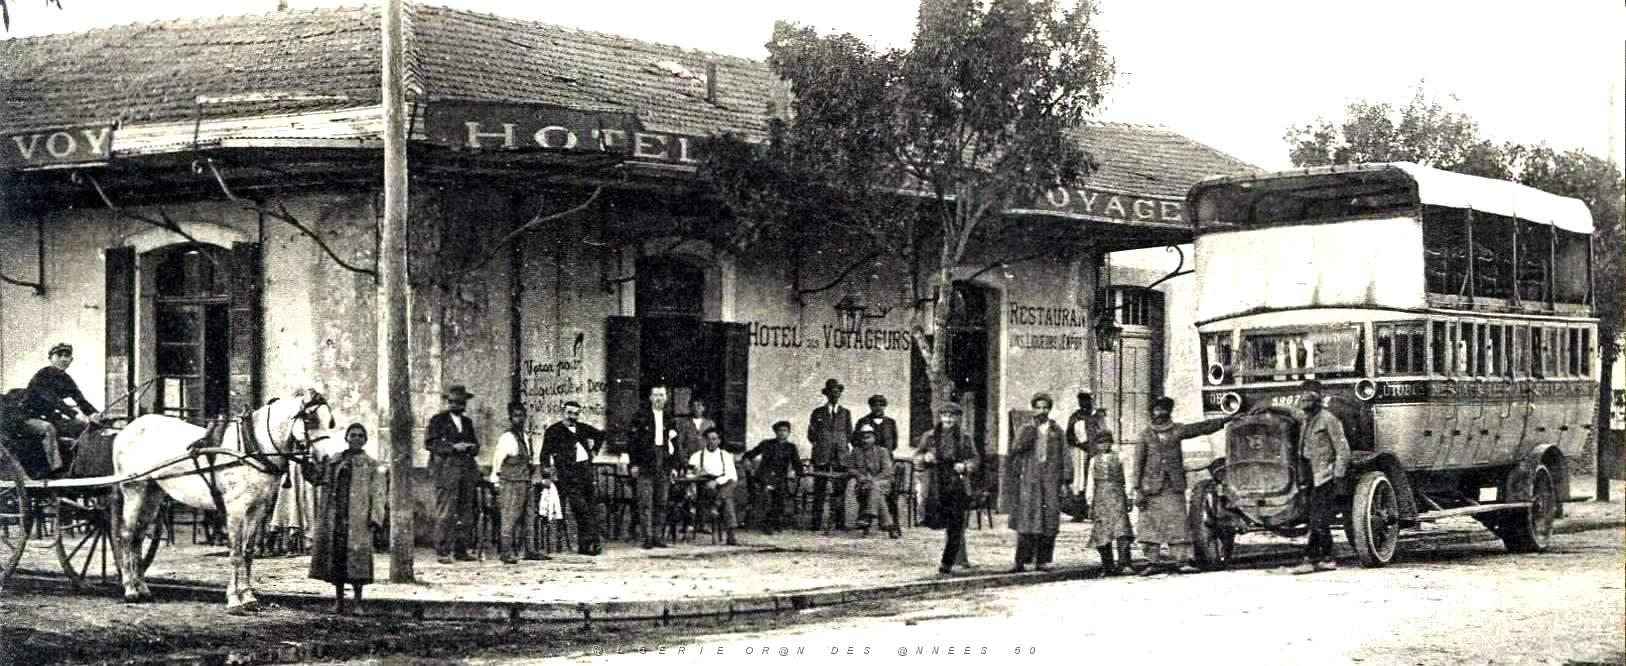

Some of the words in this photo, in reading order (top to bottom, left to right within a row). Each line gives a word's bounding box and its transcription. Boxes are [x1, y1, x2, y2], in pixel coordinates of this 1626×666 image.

[12, 127, 111, 159] VOY
[465, 120, 698, 164] HOTEL
[748, 320, 802, 348] HOTEL
[823, 324, 911, 351] VOYAGEURS
